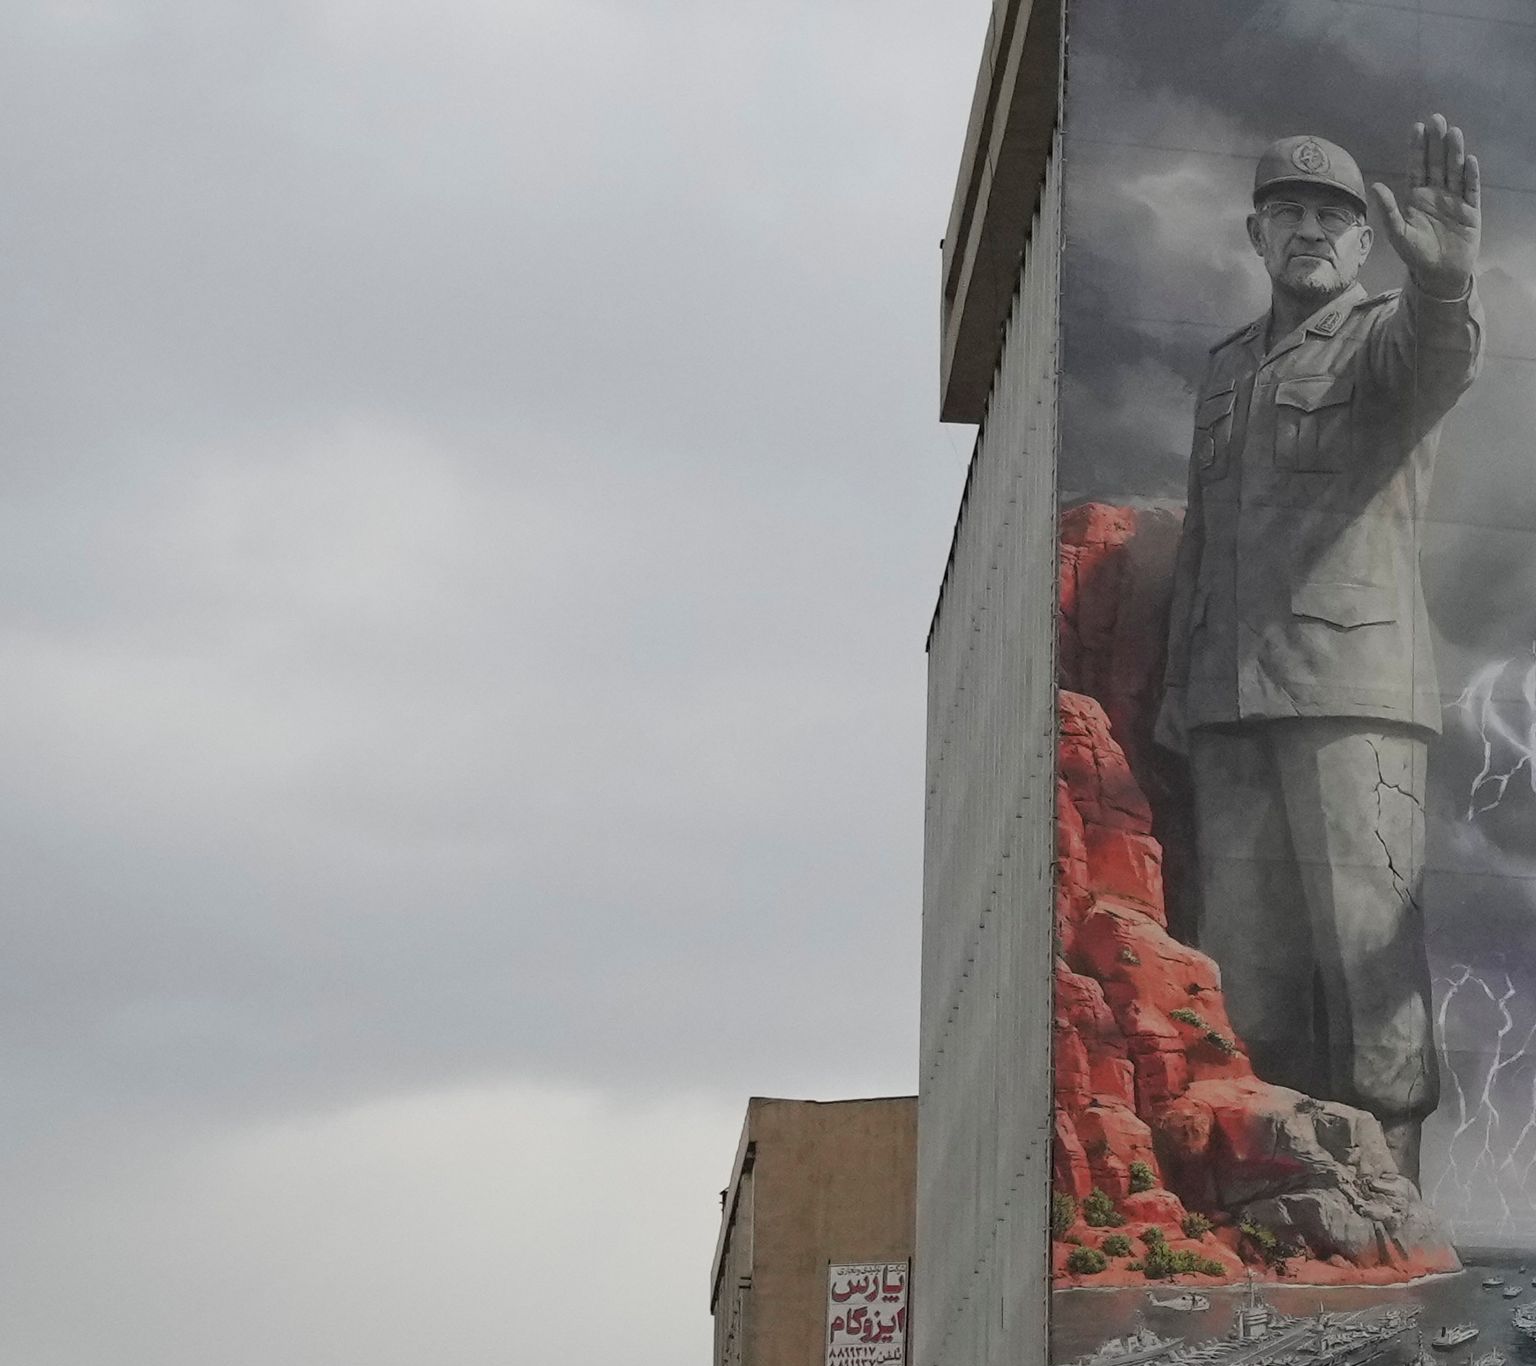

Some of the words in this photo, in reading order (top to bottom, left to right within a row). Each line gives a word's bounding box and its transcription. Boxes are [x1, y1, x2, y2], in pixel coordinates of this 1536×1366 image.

[831, 1264, 905, 1303] پارس
[830, 1306, 906, 1344] ایزوگام
[877, 1348, 902, 1364] تلفن
